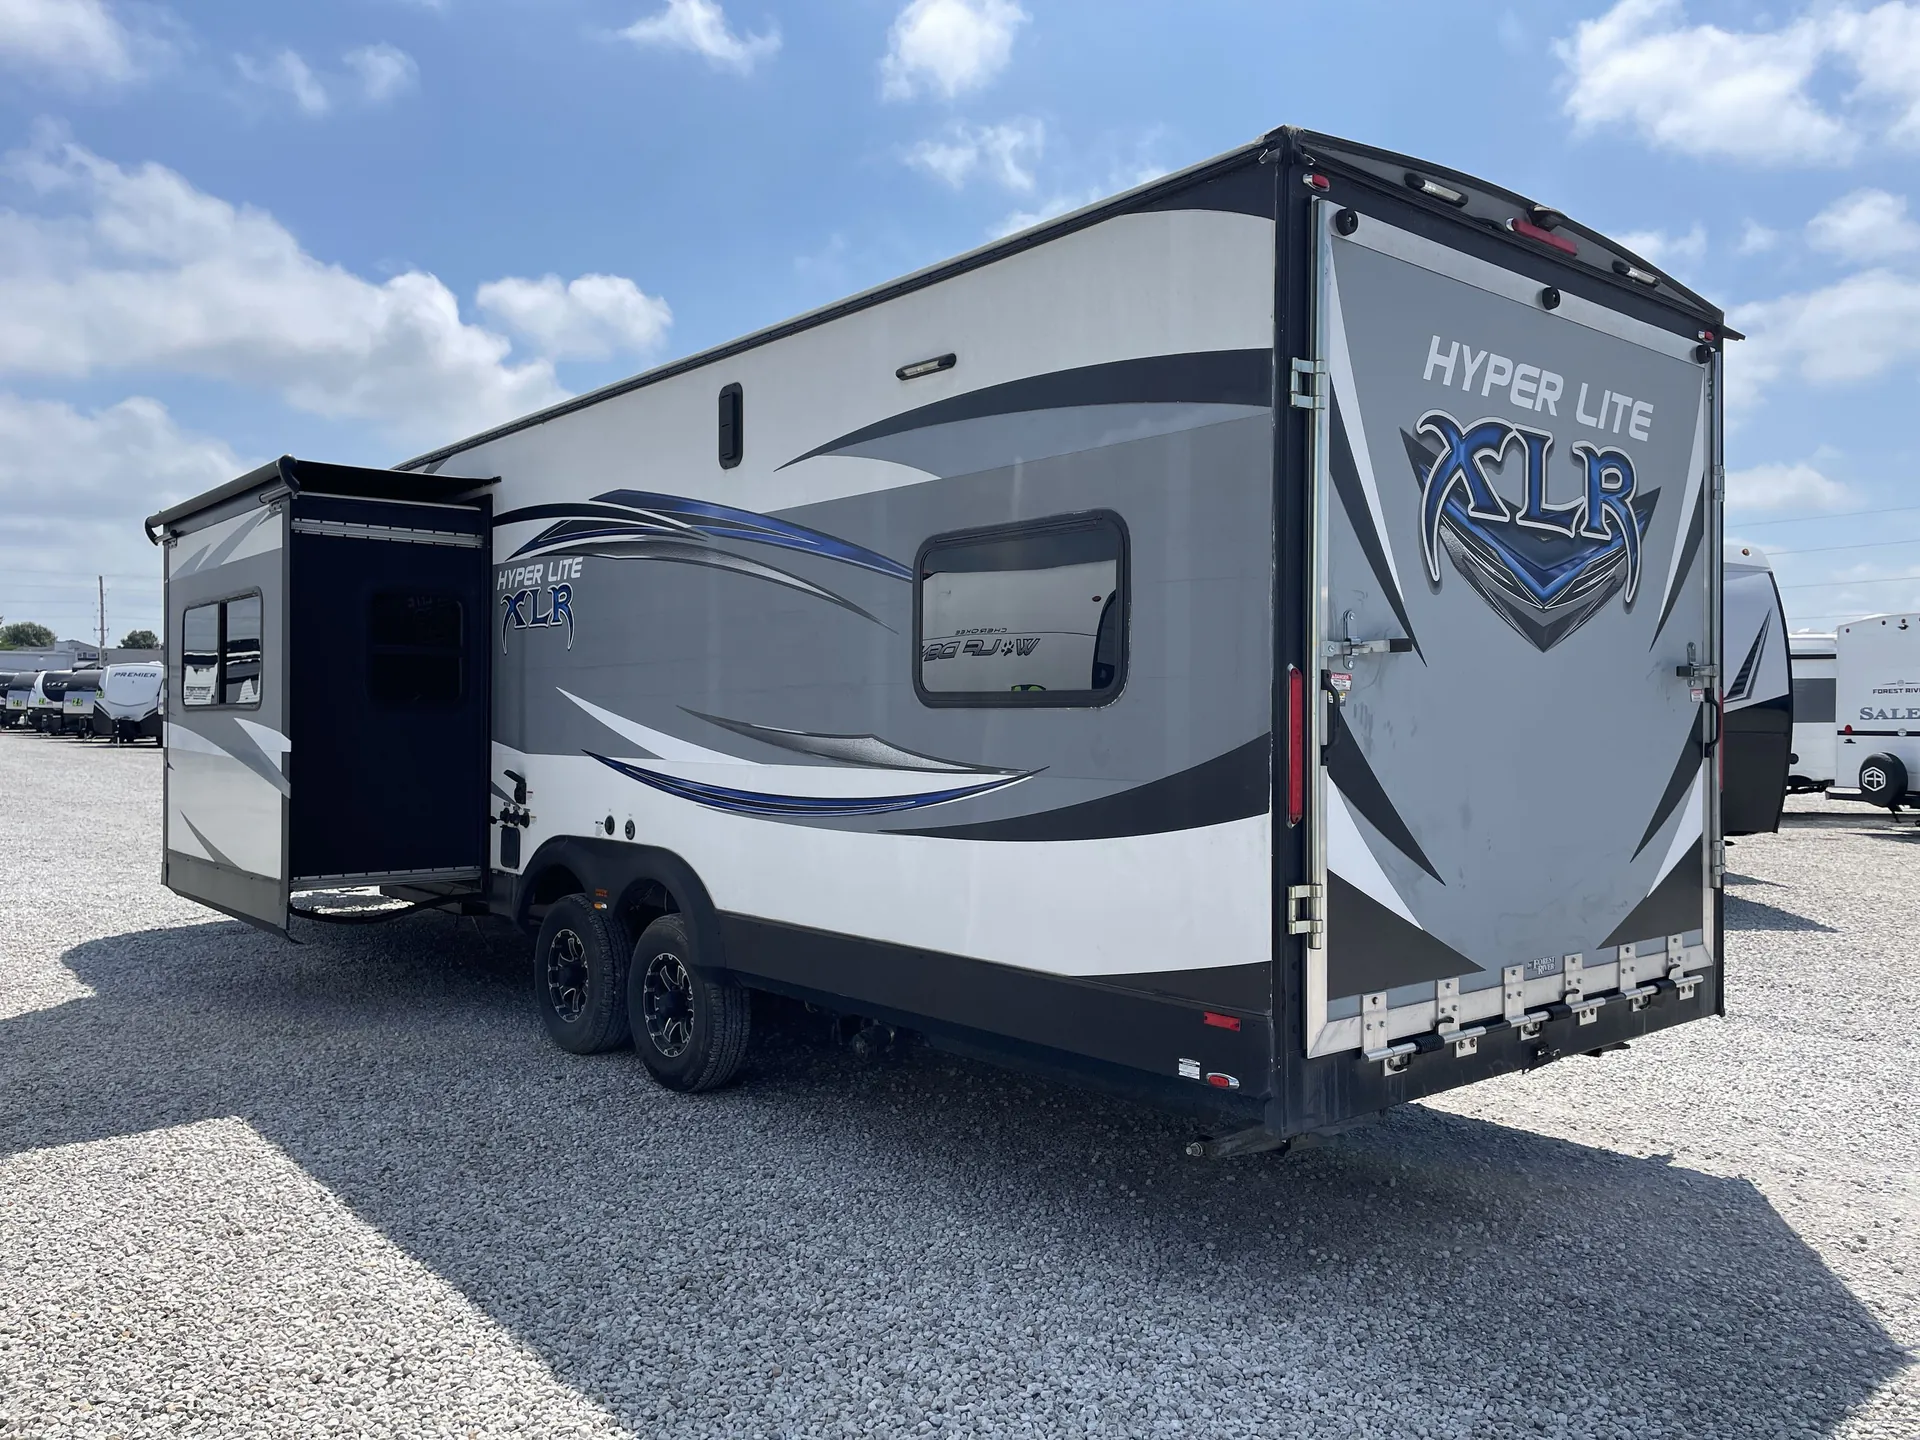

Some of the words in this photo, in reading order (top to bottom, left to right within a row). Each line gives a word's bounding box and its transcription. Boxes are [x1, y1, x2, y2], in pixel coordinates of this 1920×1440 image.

[1423, 335, 1564, 416] HYPER
[1575, 382, 1654, 442] LITE
[1416, 409, 1641, 603] XLR
[497, 563, 543, 591] HYPER
[548, 556, 583, 582] LITE
[500, 582, 574, 655] XLR
[1533, 956, 1555, 969] FOREST
[1537, 963, 1555, 975] RIVER
